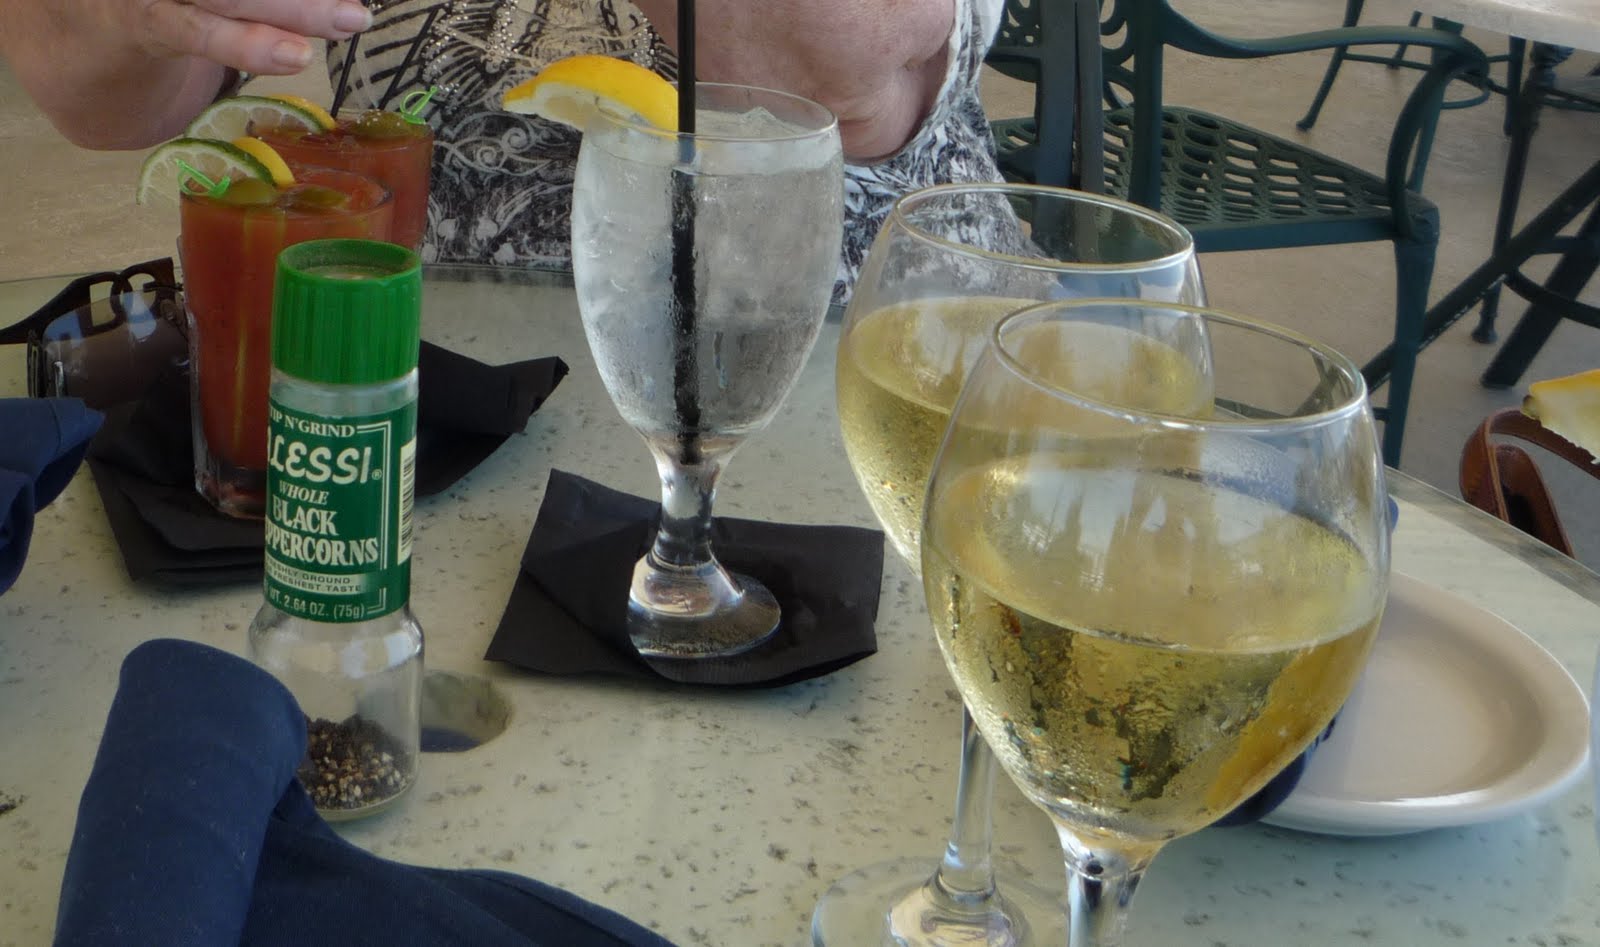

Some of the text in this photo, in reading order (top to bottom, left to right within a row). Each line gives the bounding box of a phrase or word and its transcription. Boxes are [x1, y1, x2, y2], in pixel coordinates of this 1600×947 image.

[279, 480, 329, 505] WHOLE
[273, 495, 338, 535] BLACK
[302, 572, 350, 584] GROUND
[326, 584, 362, 593] TASTE
[283, 594, 306, 612] 2.64
[309, 601, 329, 617] OZ.
[333, 603, 365, 619] (75g)
